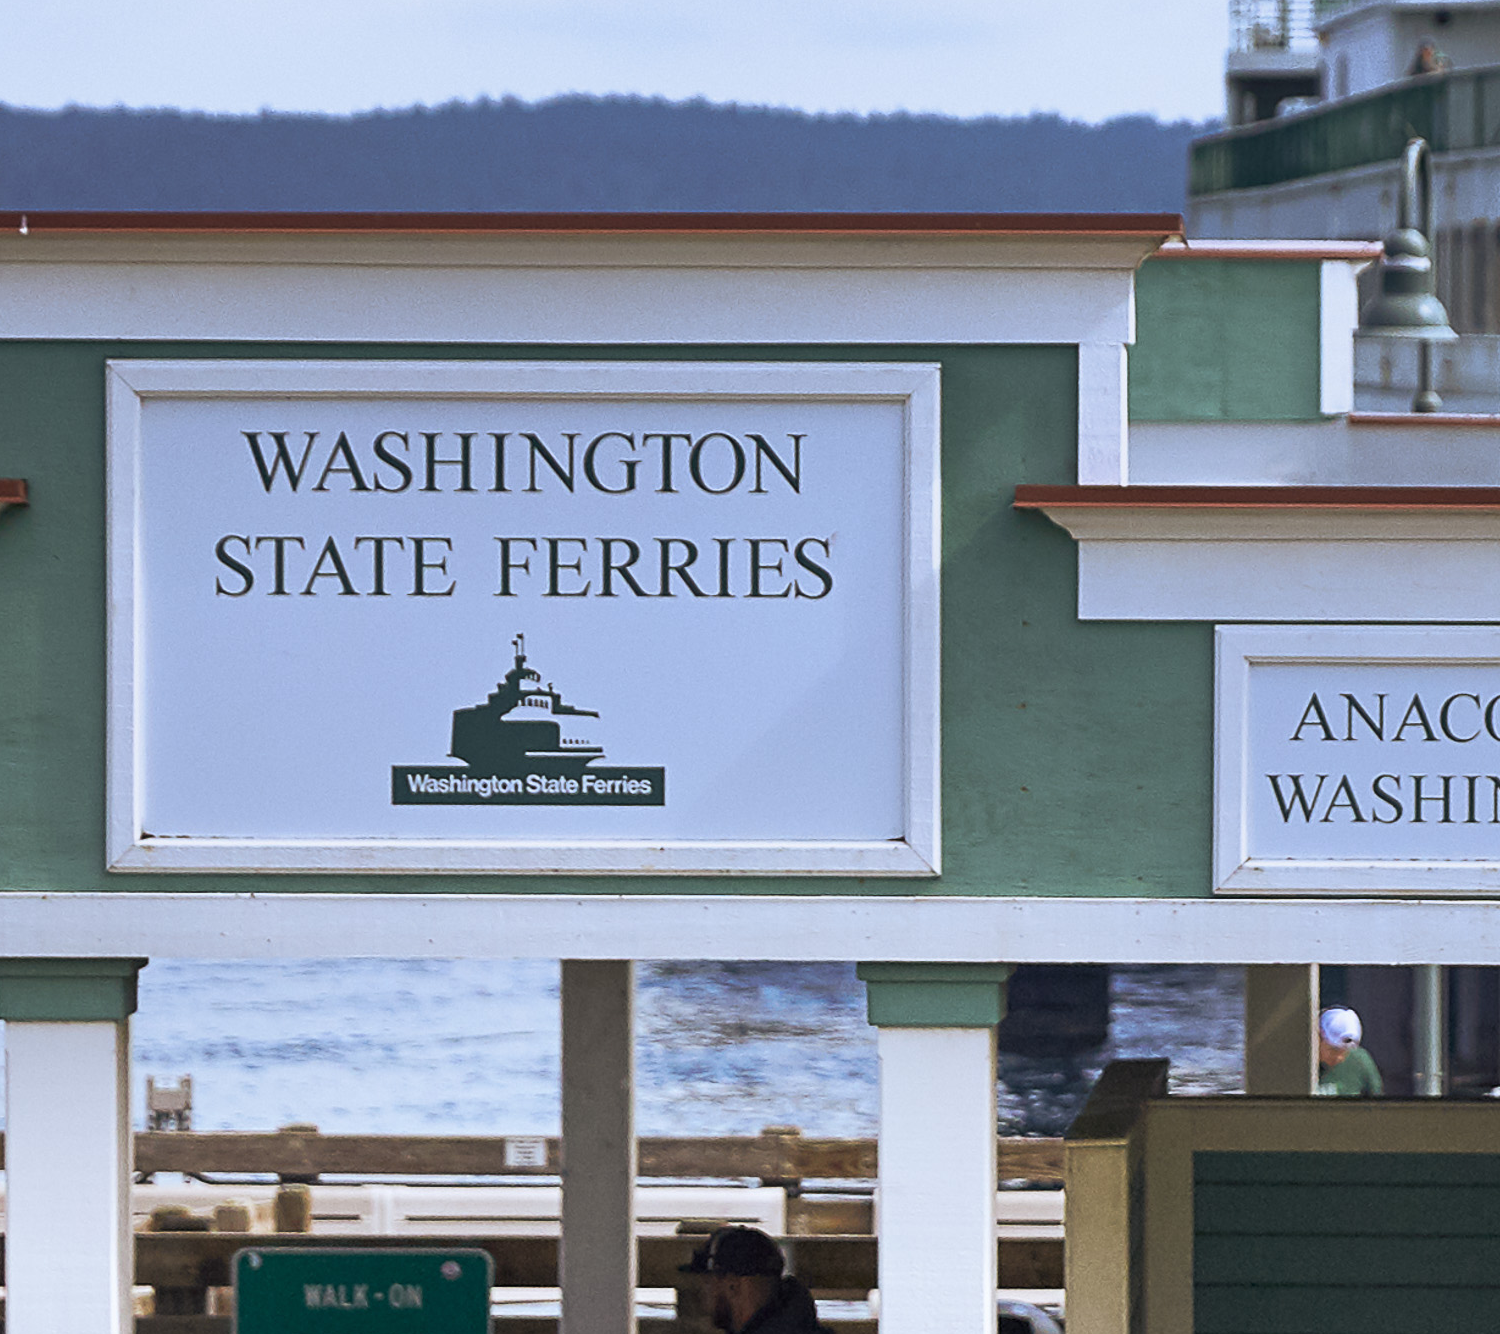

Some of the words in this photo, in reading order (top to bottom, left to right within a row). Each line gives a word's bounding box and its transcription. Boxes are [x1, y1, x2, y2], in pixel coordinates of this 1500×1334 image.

[242, 430, 808, 496] WASHINGTON
[213, 535, 456, 598] STATE
[492, 536, 835, 600] FERRIES
[407, 774, 523, 799] Washington
[526, 774, 579, 796] State
[582, 774, 652, 796] Ferries
